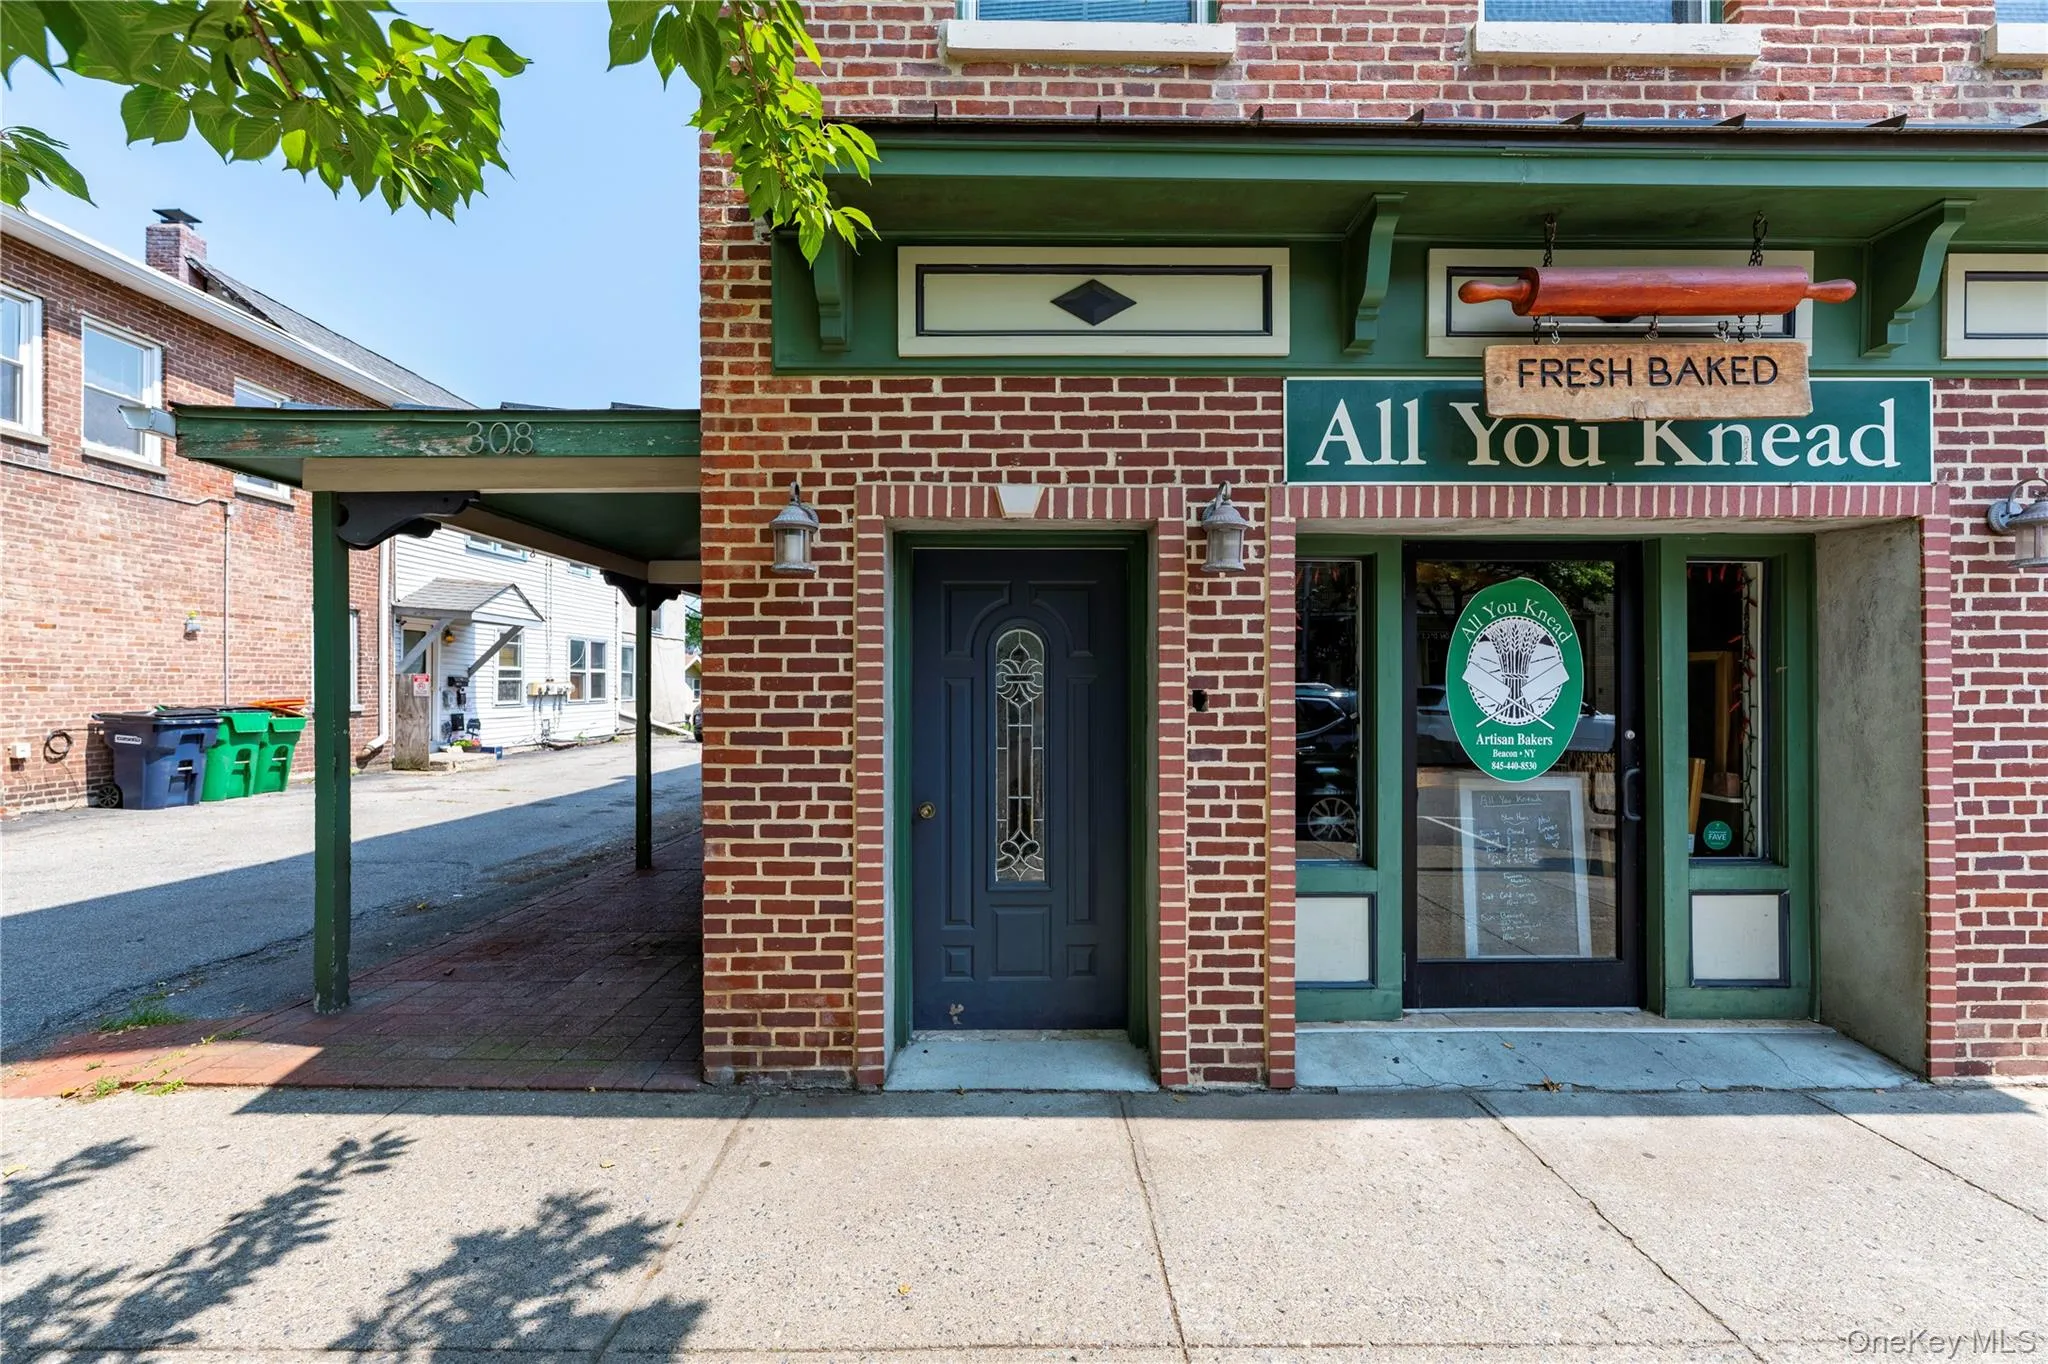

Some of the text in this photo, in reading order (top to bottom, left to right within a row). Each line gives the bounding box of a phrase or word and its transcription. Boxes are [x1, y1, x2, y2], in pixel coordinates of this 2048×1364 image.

[1518, 355, 1778, 388] FRESH BAKED
[465, 421, 534, 455] 308
[1305, 397, 1902, 468] All You Knead
[1461, 598, 1573, 644] All You Knead
[1476, 733, 1554, 746] Artisan Bakers
[1492, 749, 1537, 759] Beacon NY
[1491, 761, 1538, 771] 845-440-8530
[1708, 833, 1727, 841] FAVE
